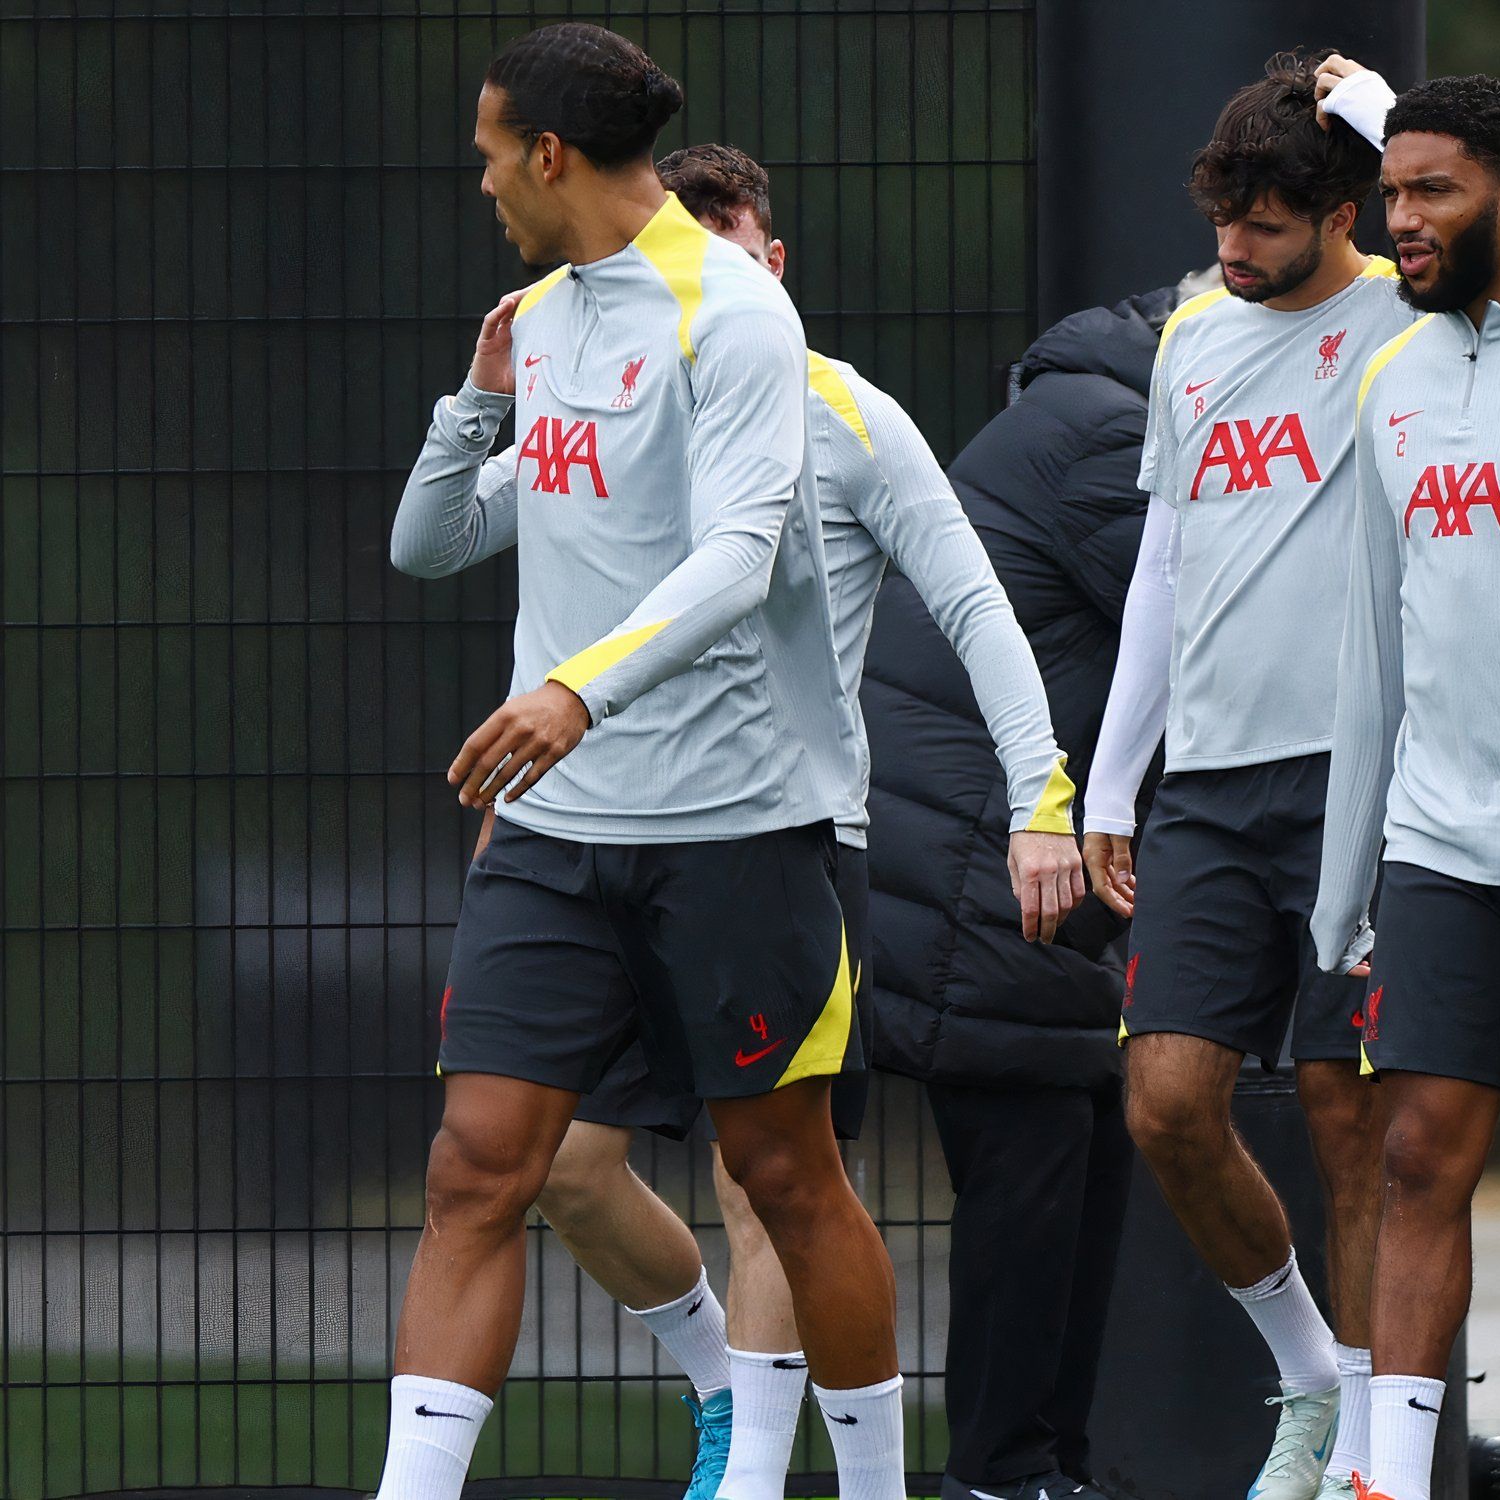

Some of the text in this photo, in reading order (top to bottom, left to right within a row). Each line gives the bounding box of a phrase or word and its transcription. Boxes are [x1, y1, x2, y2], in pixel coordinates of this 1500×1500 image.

[518, 416, 608, 498] AXA
[1190, 413, 1322, 500] AXA
[1396, 431, 1406, 457] 2
[750, 1013, 768, 1040] 4
